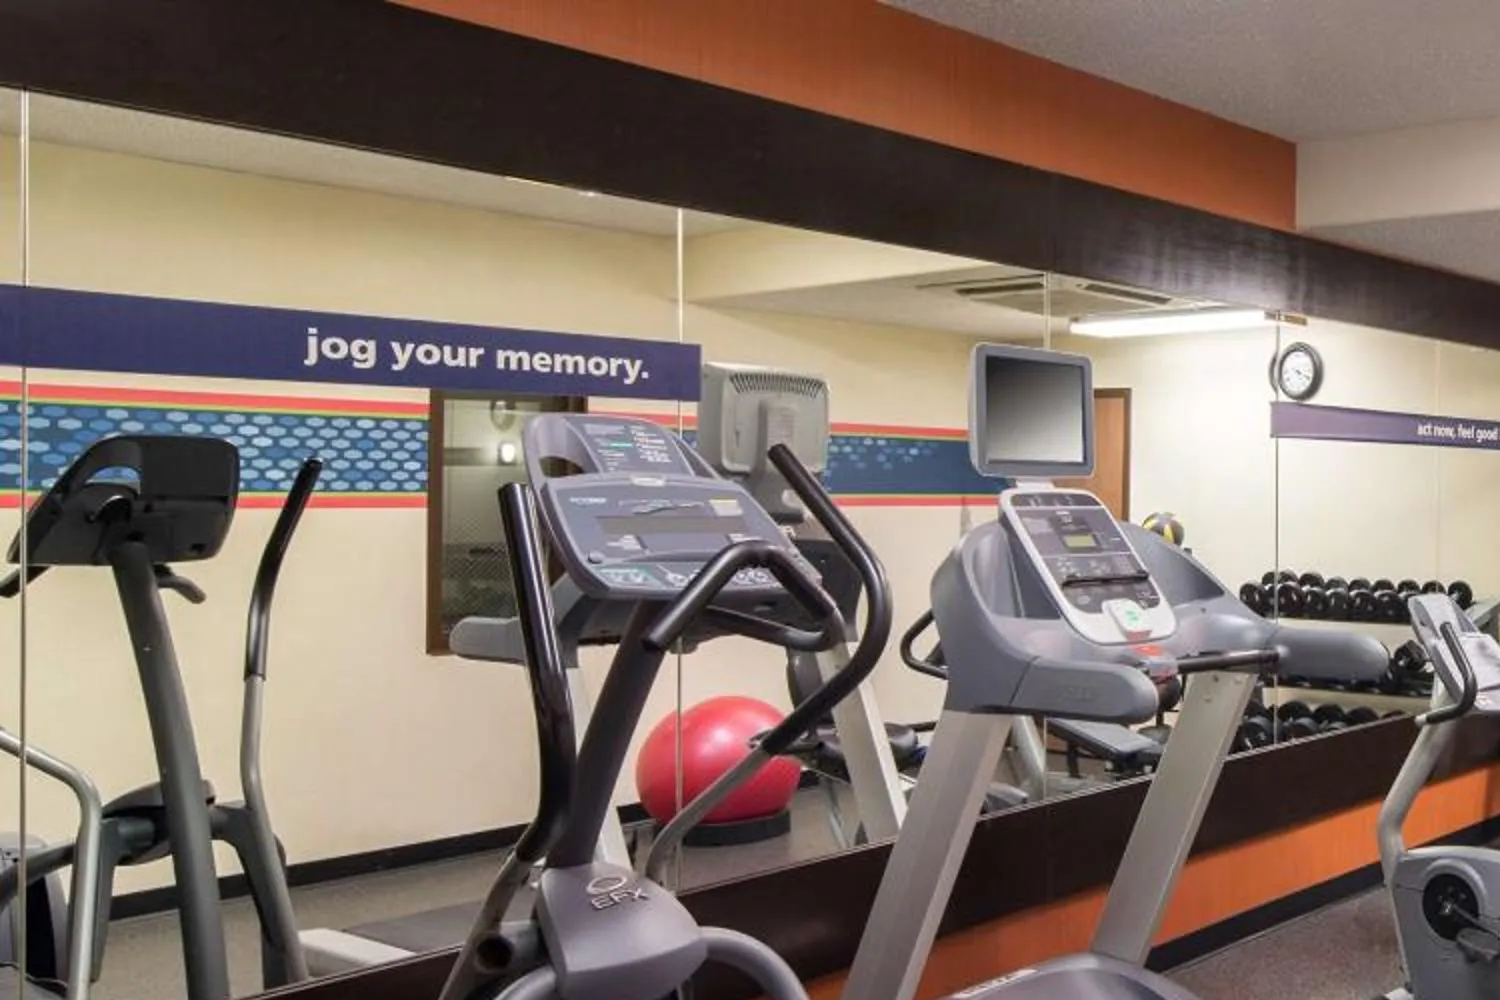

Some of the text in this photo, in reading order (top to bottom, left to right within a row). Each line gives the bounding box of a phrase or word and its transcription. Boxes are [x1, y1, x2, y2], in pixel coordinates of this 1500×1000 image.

[304, 327, 650, 384] jog your memory.
[1417, 423, 1432, 437] act
[1457, 423, 1475, 439] feel
[1476, 427, 1498, 443] good
[591, 887, 650, 911] EFX
